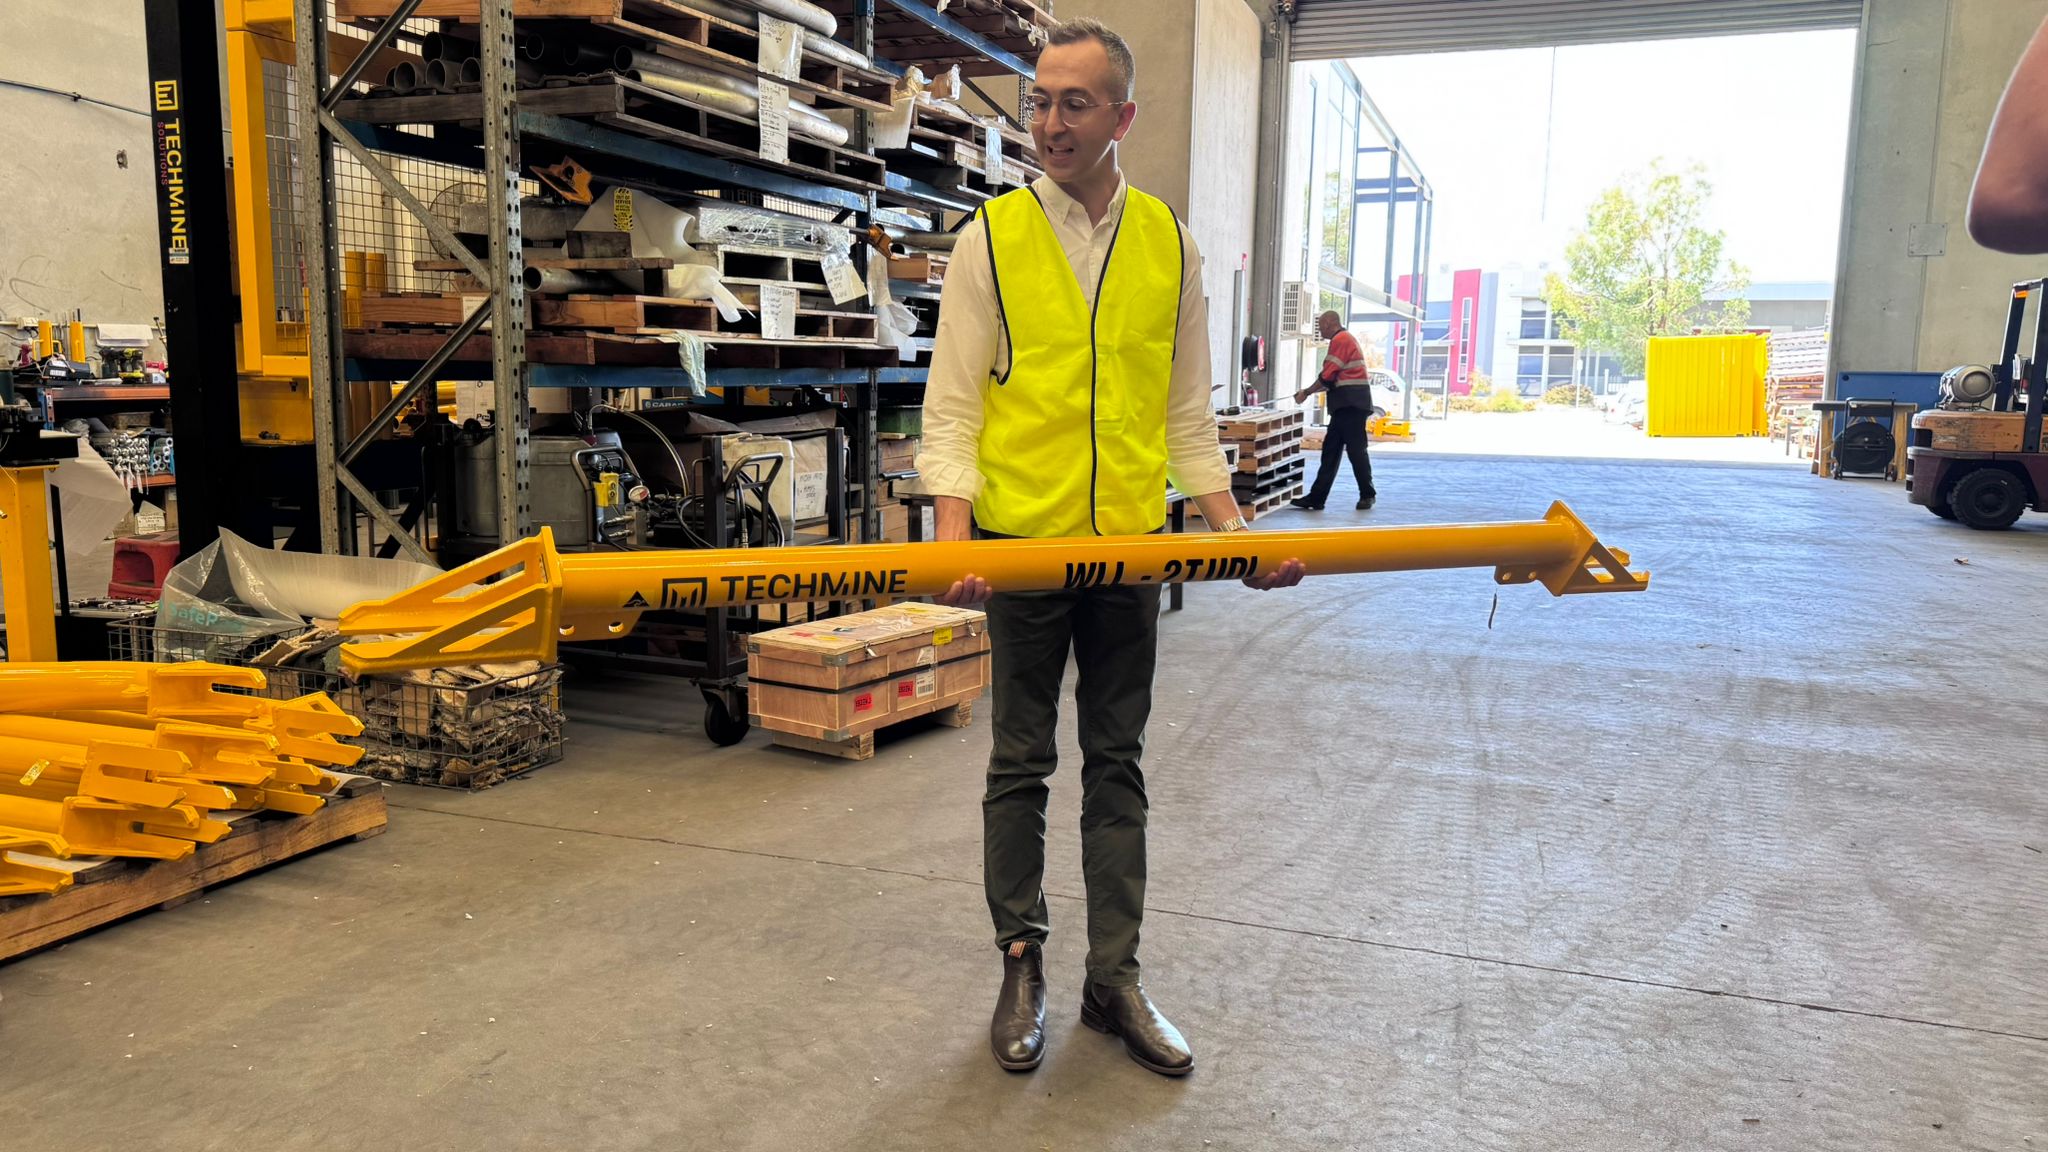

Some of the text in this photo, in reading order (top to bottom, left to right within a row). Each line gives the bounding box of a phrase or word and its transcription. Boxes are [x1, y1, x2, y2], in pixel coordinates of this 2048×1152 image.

[156, 121, 169, 186] SOLUTIONS
[164, 117, 188, 252] TECHMINE
[720, 569, 908, 601] TECHMINE
